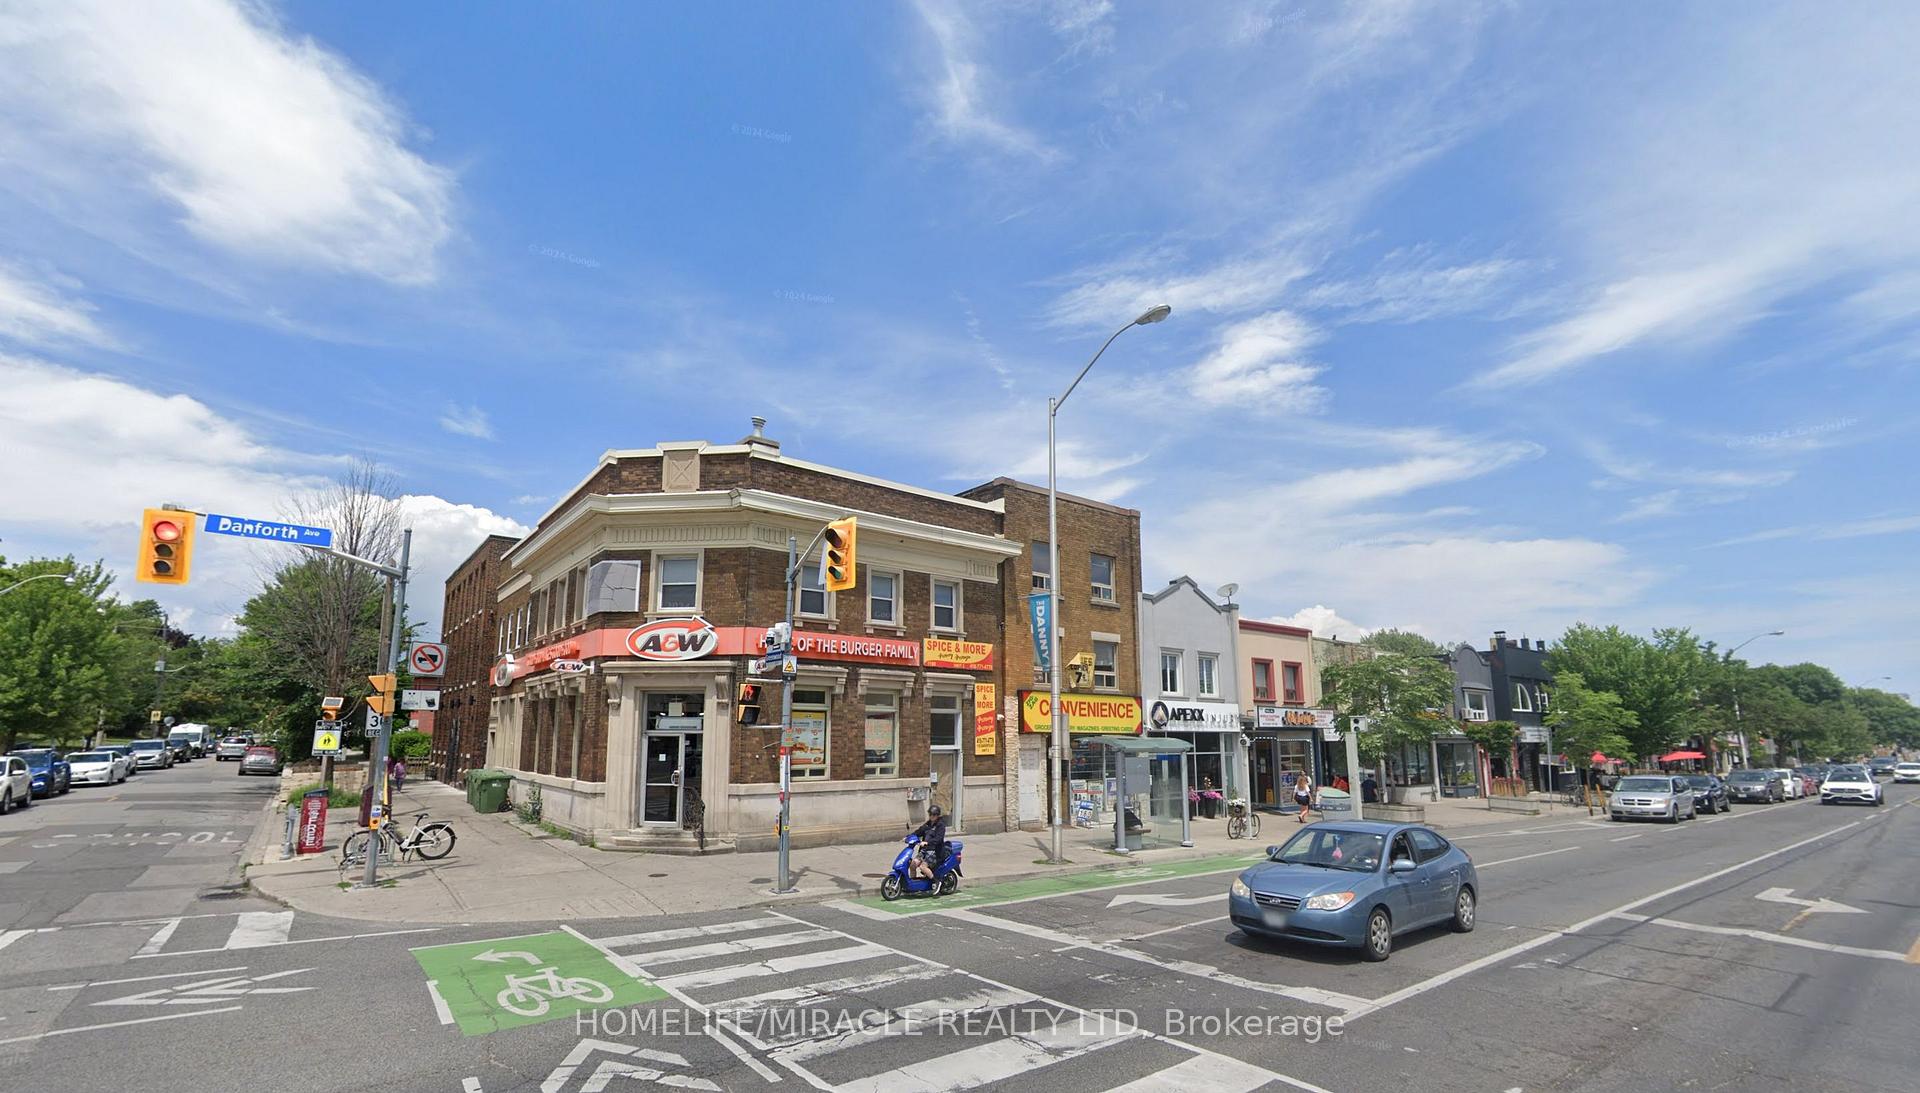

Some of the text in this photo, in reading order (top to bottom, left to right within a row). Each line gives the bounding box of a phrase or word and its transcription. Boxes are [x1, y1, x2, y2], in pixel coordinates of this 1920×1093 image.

[218, 517, 320, 540] Danforth Ave
[1036, 606, 1049, 660] DANNY
[640, 632, 710, 652] A&W
[797, 637, 814, 652] OF
[816, 638, 837, 653] THE
[839, 641, 882, 656] BURGER
[884, 644, 919, 659] FAMILY
[926, 640, 986, 655] SPICE & MORE
[557, 663, 583, 671] A&W
[976, 685, 994, 693] SPICE
[976, 701, 994, 709] MORE
[1040, 699, 1133, 718] CNVENIENCE
[1170, 707, 1205, 721] APEXX
